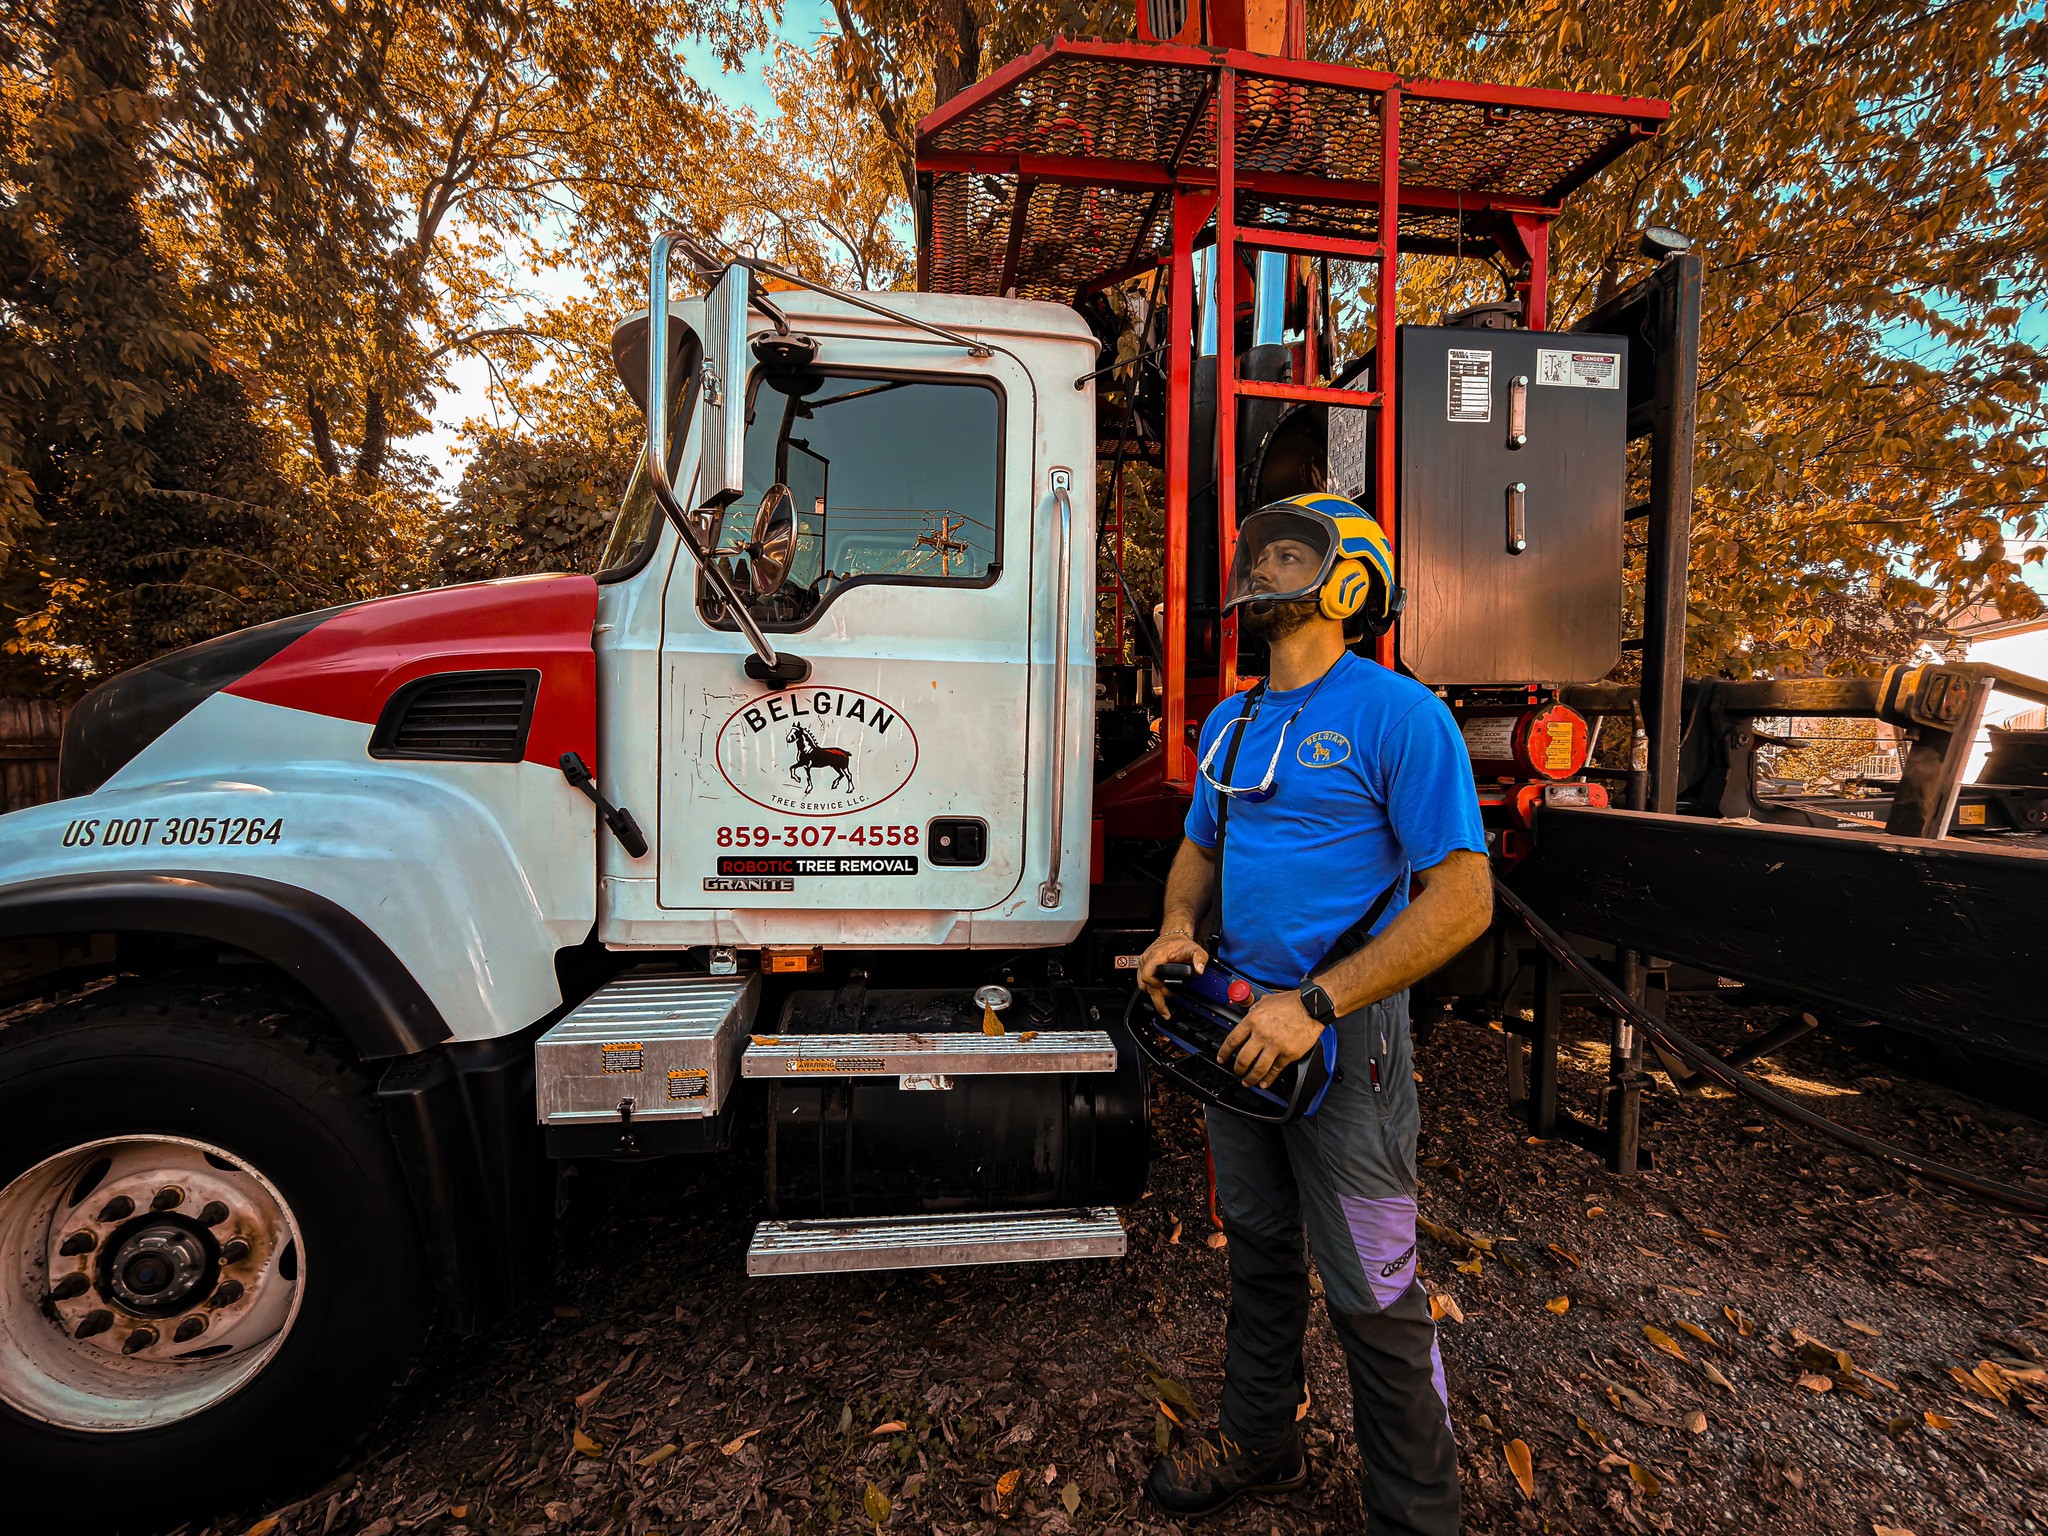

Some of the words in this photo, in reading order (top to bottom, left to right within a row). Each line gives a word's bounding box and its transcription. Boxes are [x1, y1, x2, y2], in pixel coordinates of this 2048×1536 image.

[743, 691, 895, 735] BELGIAN
[1306, 732, 1345, 746] BELGIAN
[771, 794, 797, 808] TREE
[800, 802, 843, 811] SERVICE
[62, 818, 100, 847] US
[102, 817, 159, 846] DOT
[161, 817, 283, 846] 3051264
[716, 825, 920, 848] 859-307-4558
[722, 860, 793, 874] ROBOTIC
[797, 860, 836, 873] TREE
[839, 859, 914, 873] REMOVAL
[703, 877, 793, 891] GRANITE
[803, 1061, 836, 1069] WARNING
